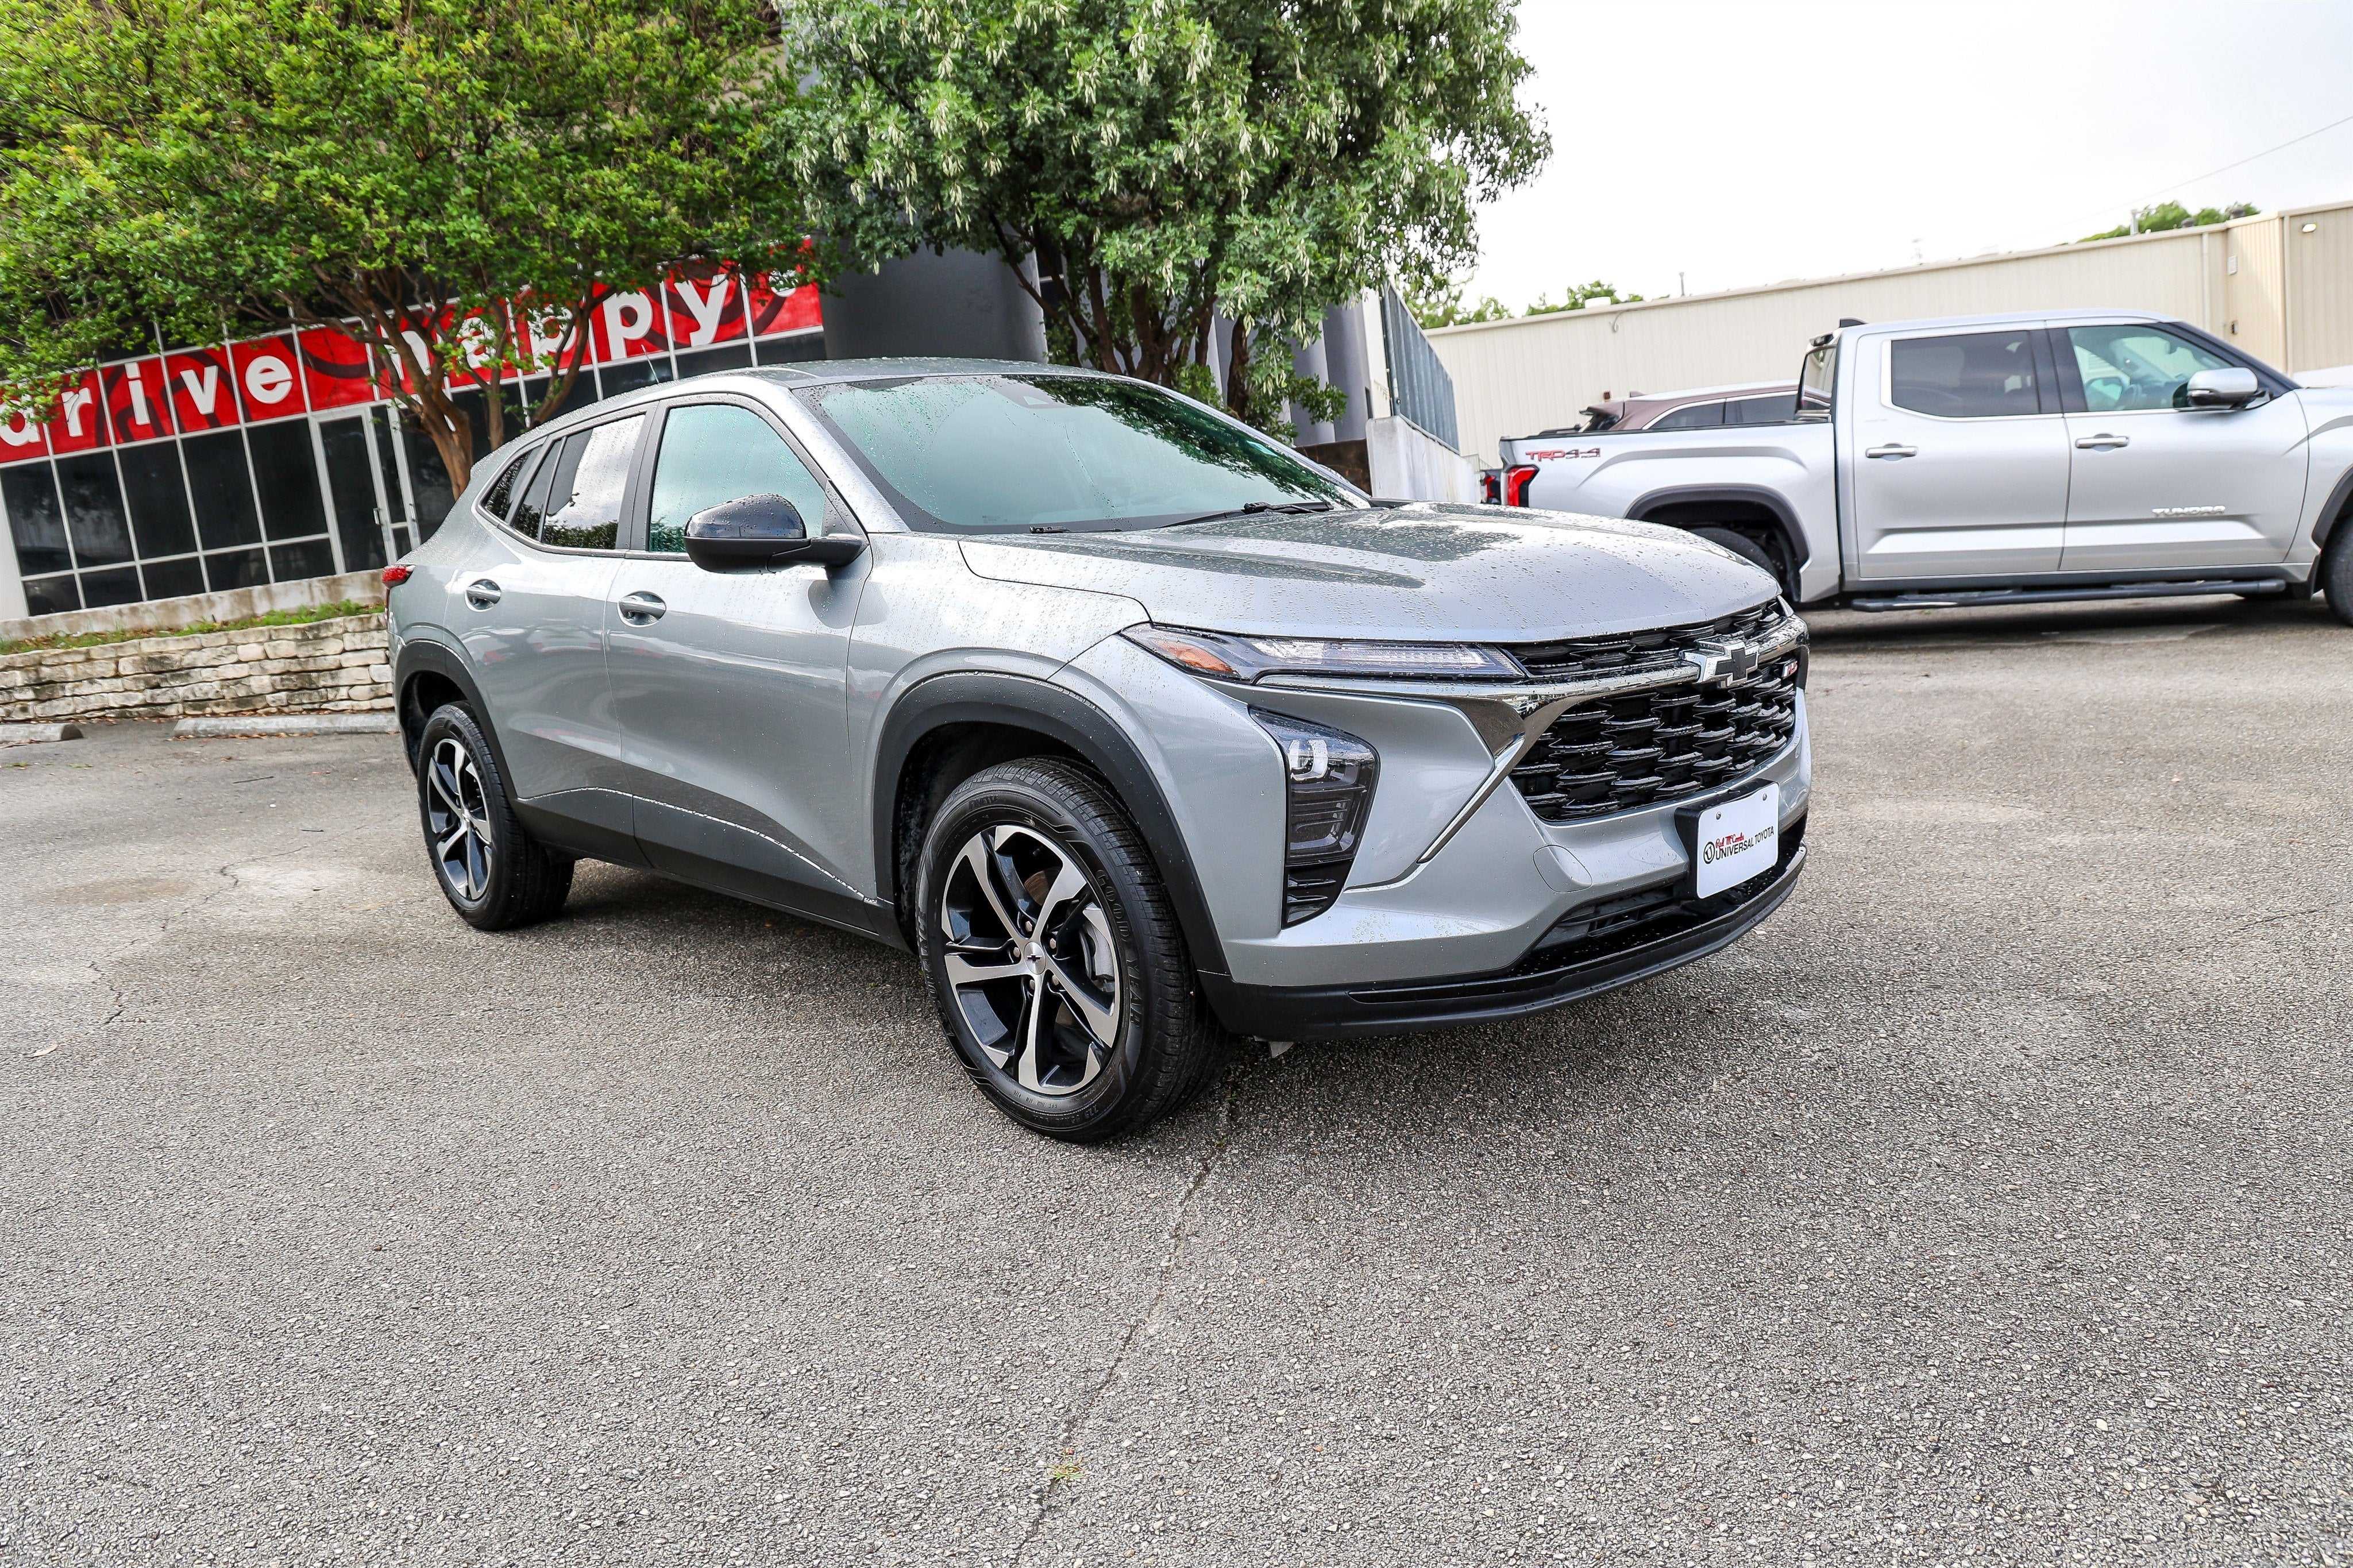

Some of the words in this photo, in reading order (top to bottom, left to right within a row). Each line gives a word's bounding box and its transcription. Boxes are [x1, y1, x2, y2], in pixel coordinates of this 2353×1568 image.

[0, 355, 293, 446] drive
[1525, 449, 1565, 462] TRD
[2151, 505, 2226, 516] TUNDRA
[1715, 838, 1725, 851] Red
[1716, 837, 1754, 860] UNIVERSAL
[1754, 826, 1775, 845] TOYOTA
